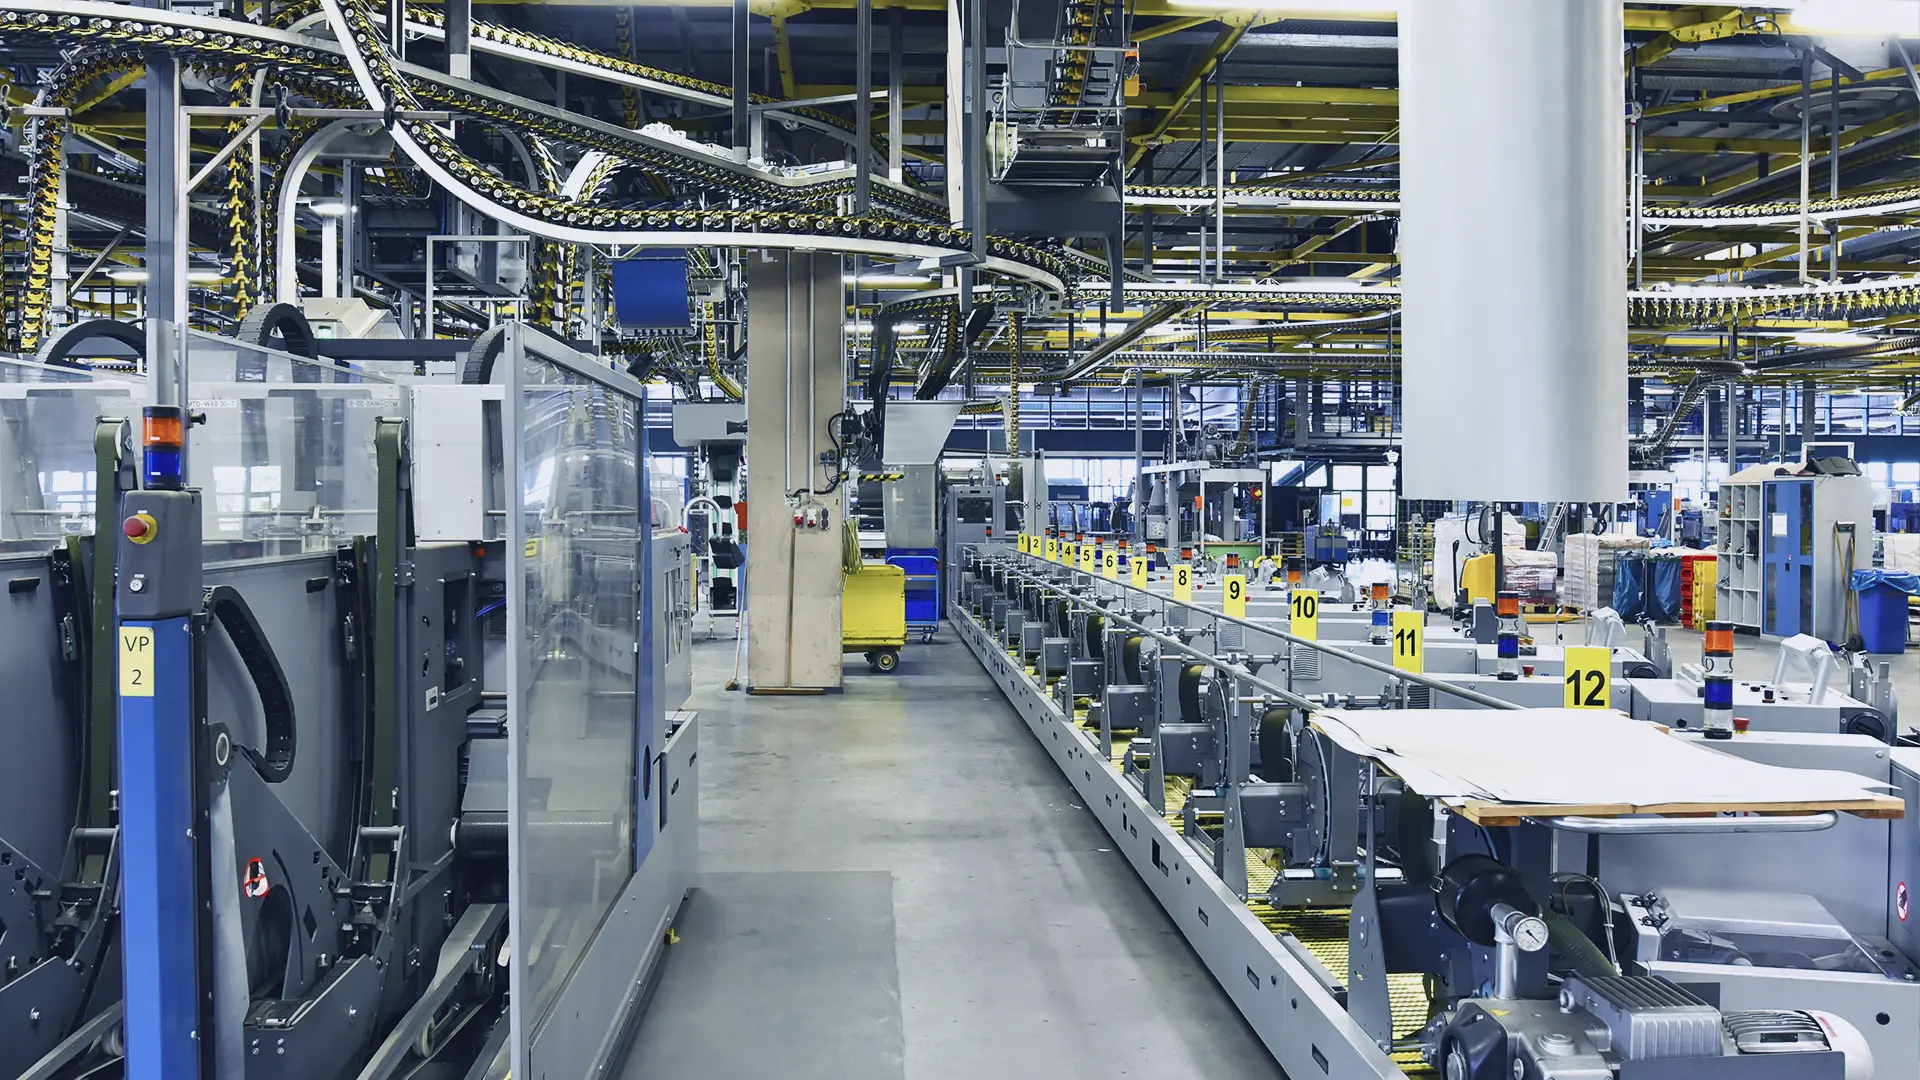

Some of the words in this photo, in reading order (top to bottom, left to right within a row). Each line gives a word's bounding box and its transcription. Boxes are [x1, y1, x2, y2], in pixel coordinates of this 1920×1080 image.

[1020, 536, 1025, 544] 1
[1033, 539, 1039, 548] 2
[1048, 542, 1055, 552] 3
[1065, 546, 1071, 556] 4
[1083, 550, 1090, 561] 5
[1106, 555, 1113, 568] 6
[1135, 561, 1143, 575] 7
[1178, 569, 1187, 586] 8
[1229, 580, 1240, 600] 9
[1292, 595, 1316, 618] 10
[124, 635, 150, 652] VP
[1395, 628, 1416, 656] 11
[131, 669, 142, 685] 2
[1566, 669, 1605, 706] 12
